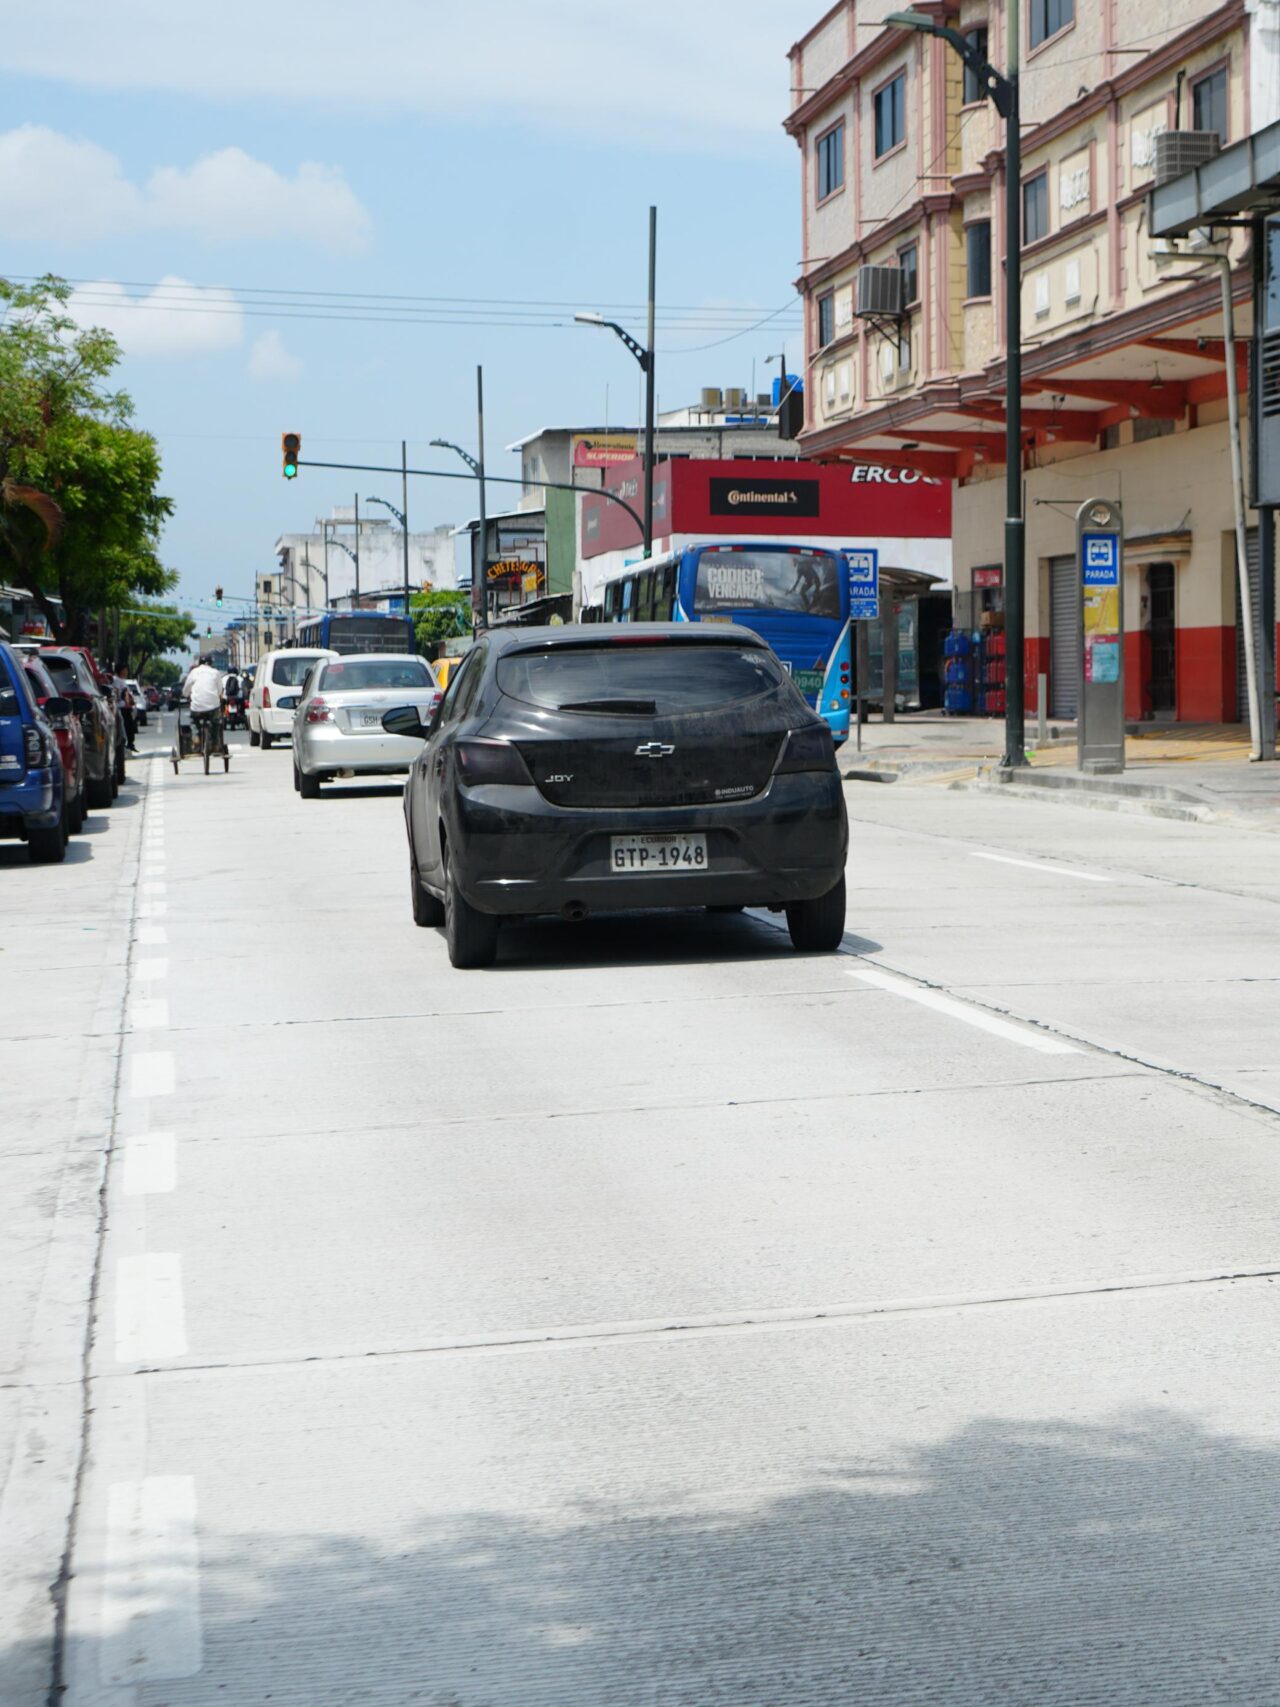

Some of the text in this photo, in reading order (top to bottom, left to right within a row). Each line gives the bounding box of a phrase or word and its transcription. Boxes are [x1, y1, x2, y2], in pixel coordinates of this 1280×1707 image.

[586, 451, 635, 461] SUPERIOR
[727, 490, 788, 506] Continental
[1085, 569, 1115, 579] PARADA
[708, 583, 766, 600] VENGANZA
[545, 774, 574, 783] JOY
[641, 836, 677, 844] ECUADOR
[614, 846, 704, 867] GTP-1948
